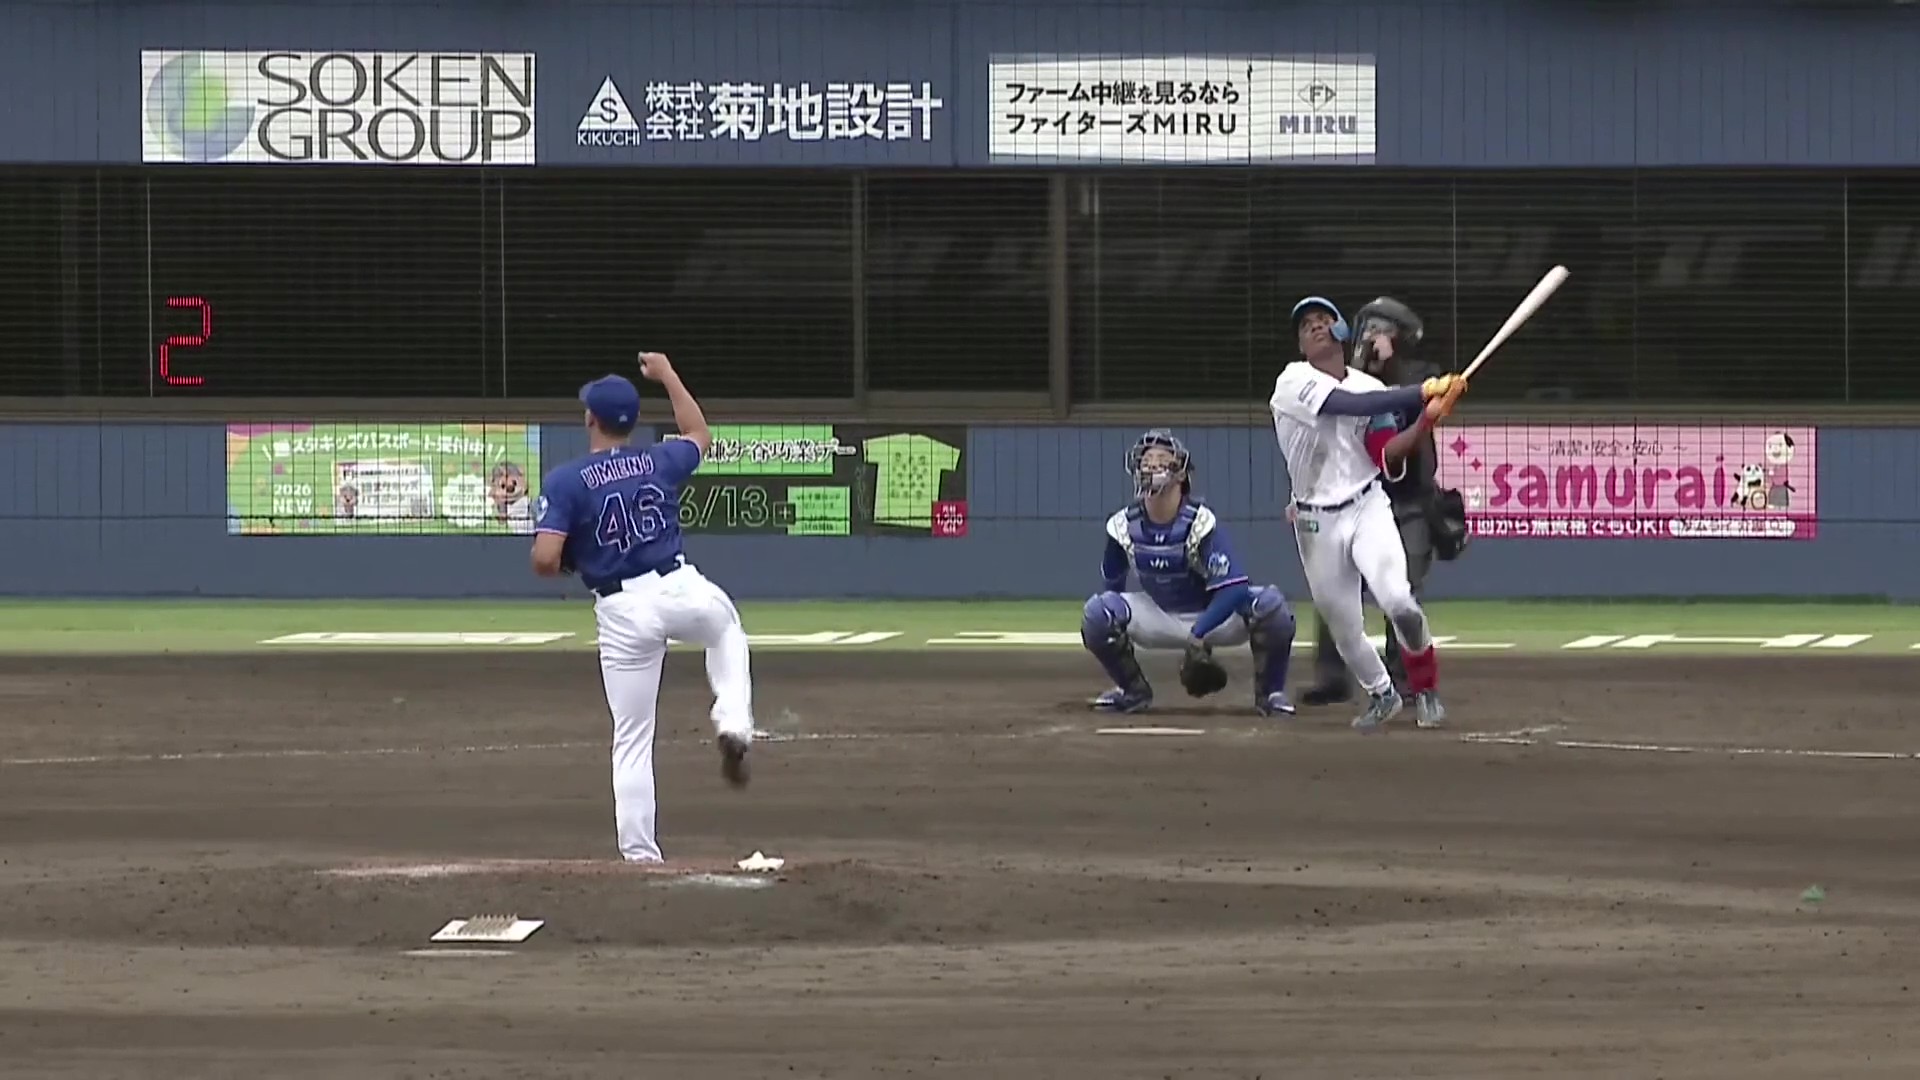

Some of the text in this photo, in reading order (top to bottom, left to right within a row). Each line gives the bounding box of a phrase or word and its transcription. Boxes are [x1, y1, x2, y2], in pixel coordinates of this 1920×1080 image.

[257, 53, 532, 107] SOKEN
[645, 81, 704, 112] 株式
[1006, 80, 1239, 105] ファーム中継を見るなら
[645, 112, 704, 141] 会社
[708, 82, 943, 141] 菊地設計
[1006, 110, 1237, 135] ファイターズMIRU
[1279, 115, 1356, 134] MIRU
[257, 107, 532, 161] GROUP
[577, 130, 640, 146] KIKUCHI
[160, 297, 211, 385] 2
[581, 454, 654, 489] UMENO
[1489, 455, 1726, 510] samurai
[273, 483, 312, 496] 2026
[273, 498, 312, 514] NEW
[595, 484, 667, 554] 46
[678, 485, 769, 528] 6/13
